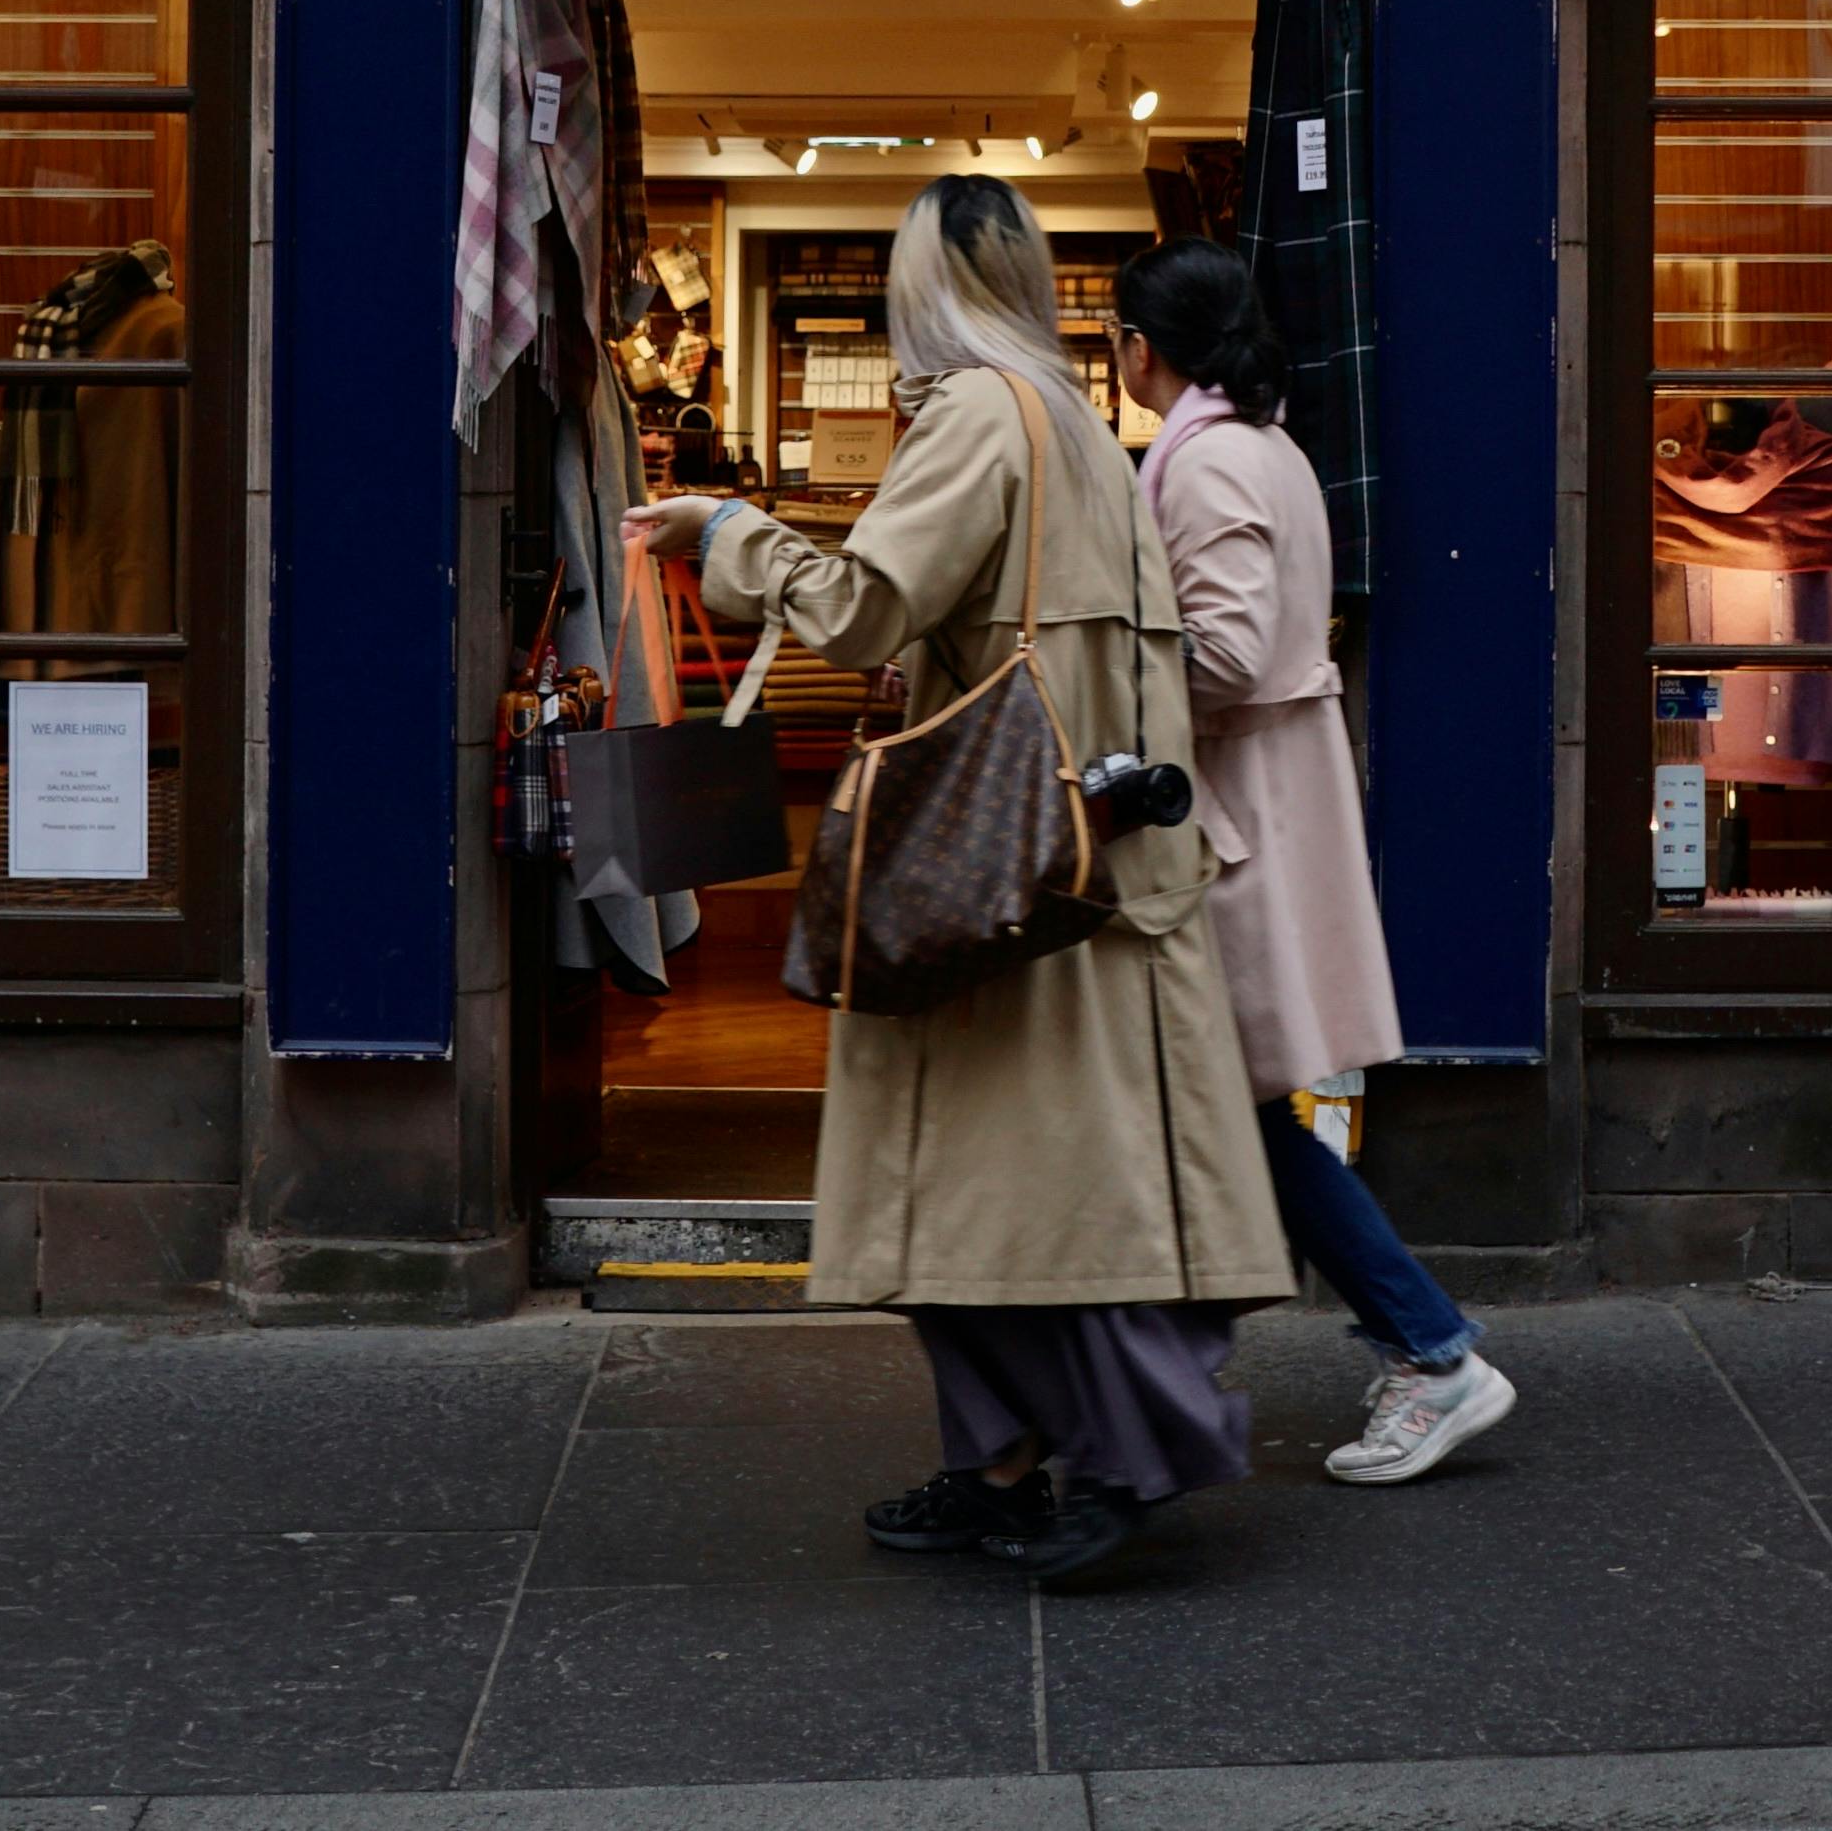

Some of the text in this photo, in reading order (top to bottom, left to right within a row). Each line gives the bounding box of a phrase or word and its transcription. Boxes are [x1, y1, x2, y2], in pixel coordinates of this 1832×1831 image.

[31, 723, 127, 735] WE ARE HIRING
